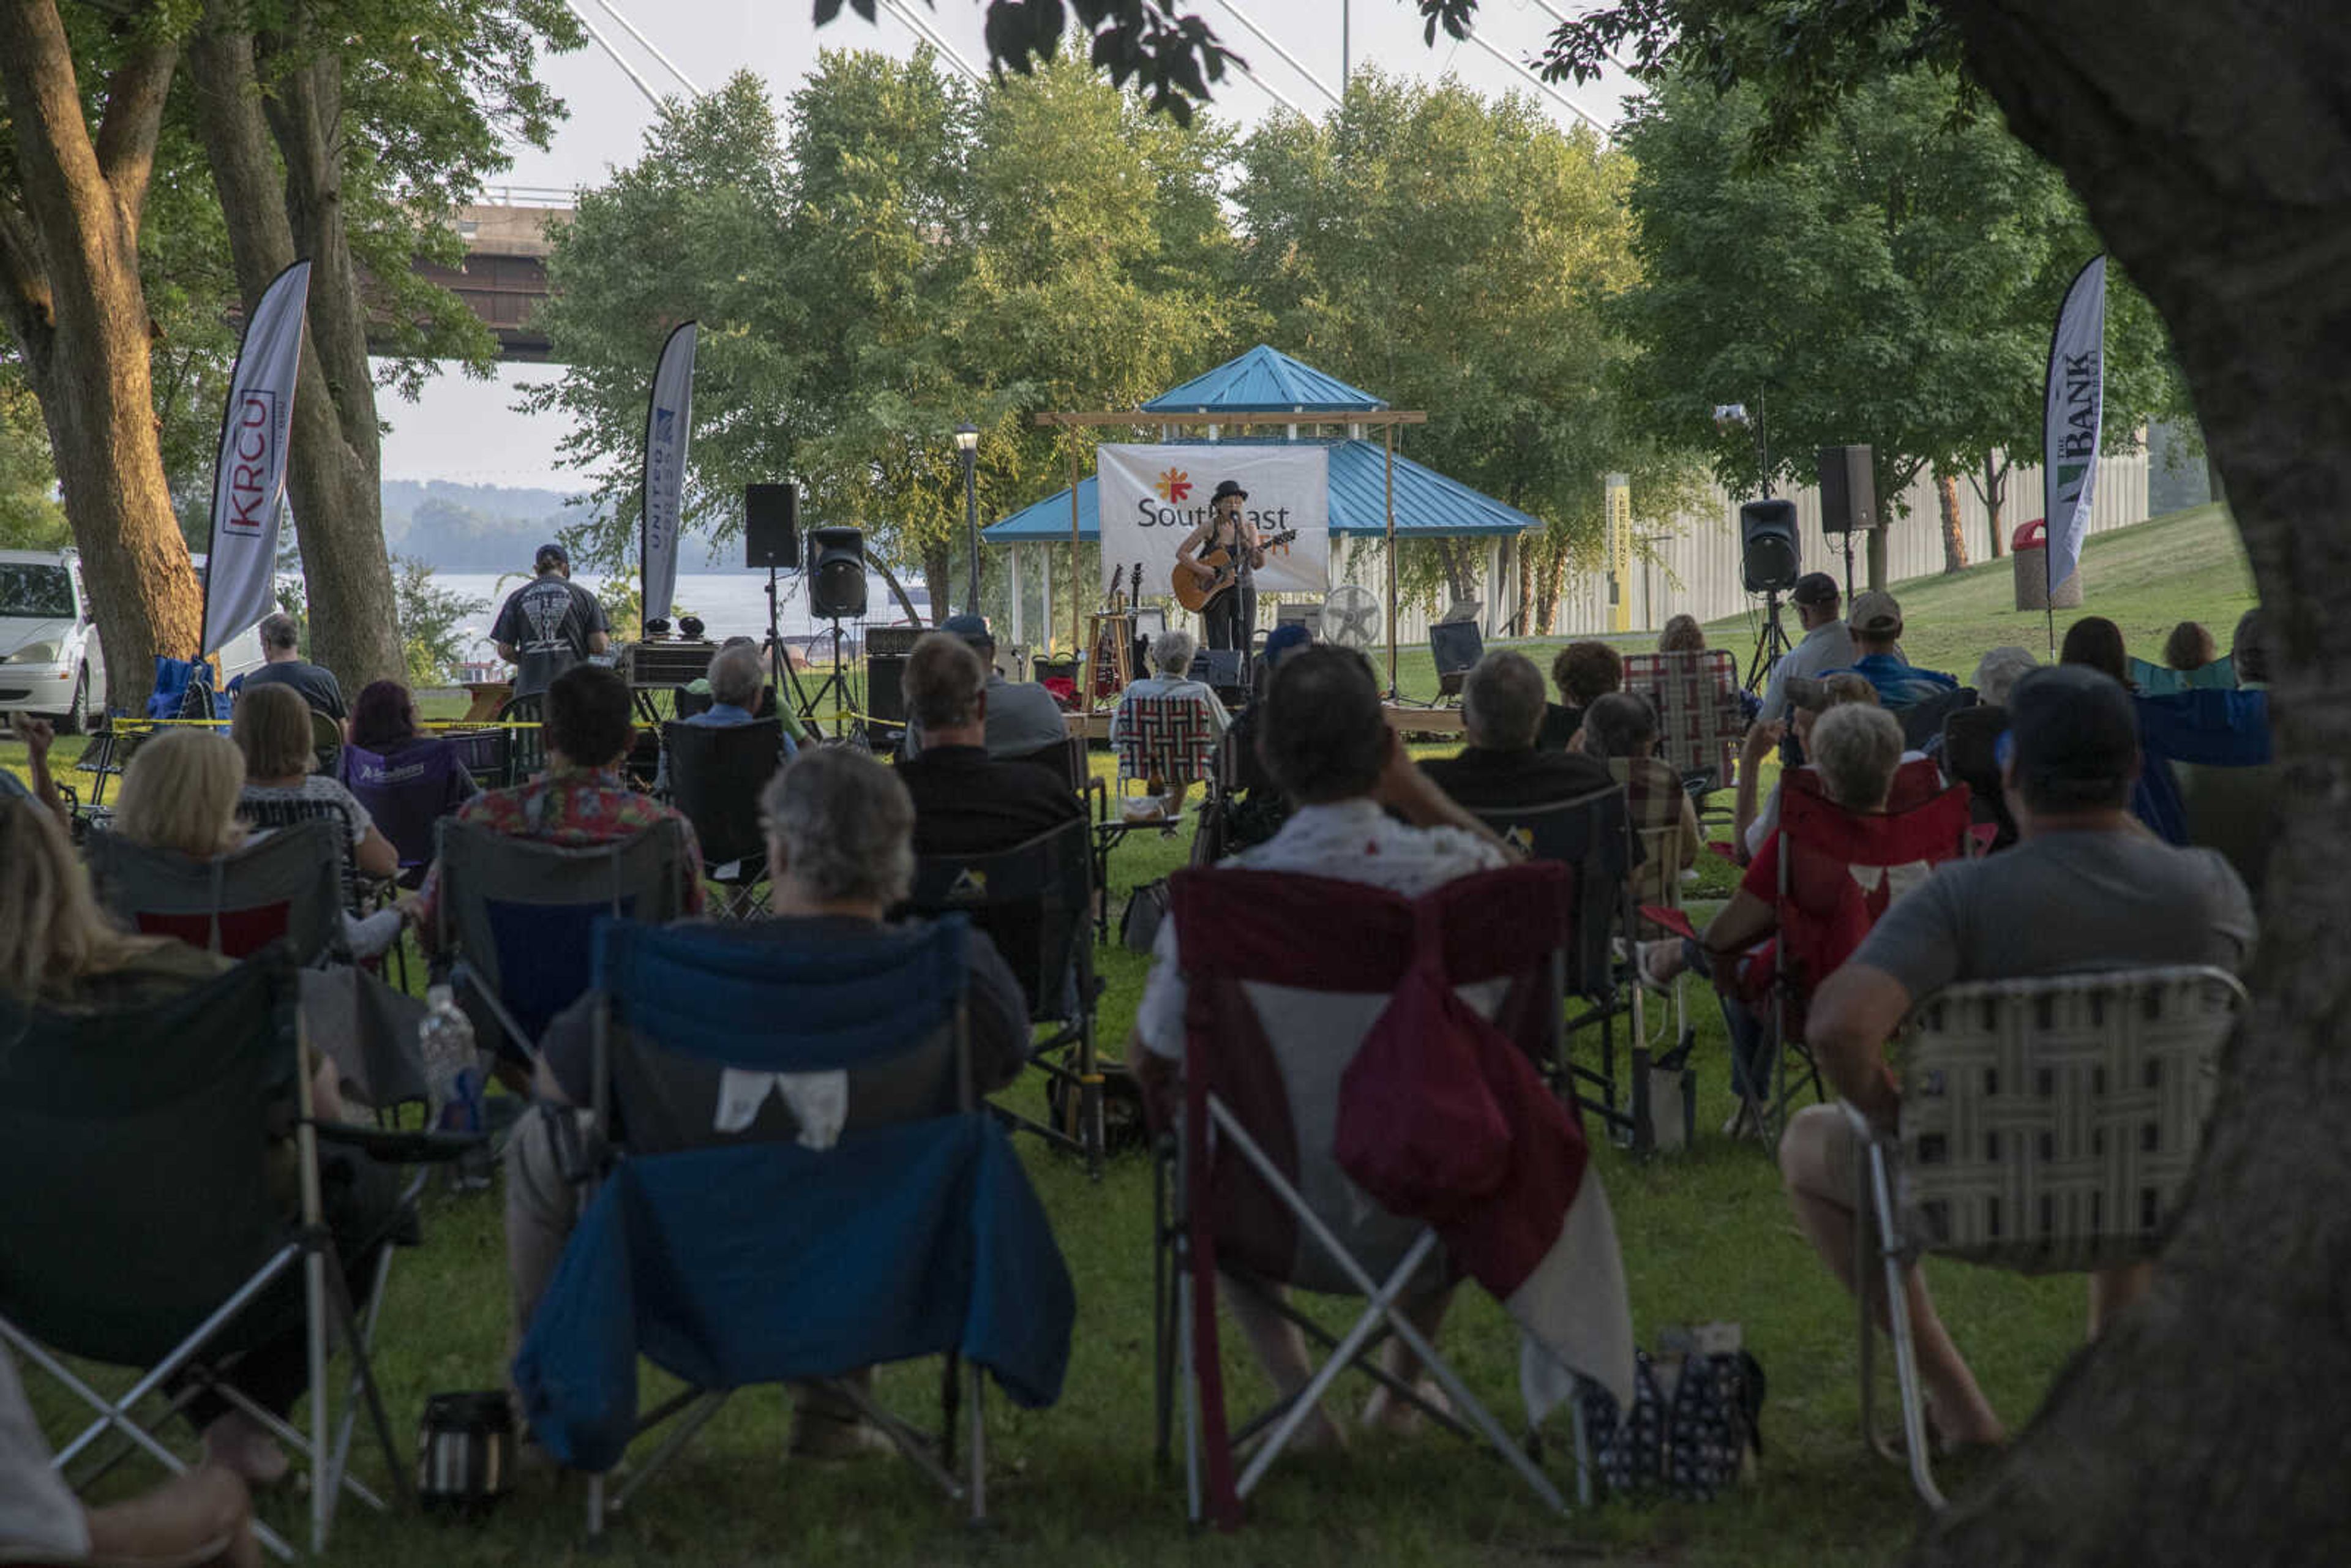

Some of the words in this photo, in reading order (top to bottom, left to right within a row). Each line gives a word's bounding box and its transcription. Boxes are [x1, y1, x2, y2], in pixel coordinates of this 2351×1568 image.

[2066, 351, 2095, 459] BANK
[231, 399, 266, 527] KRCU
[652, 448, 662, 549] UNITED
[1138, 498, 1291, 530] Southast
